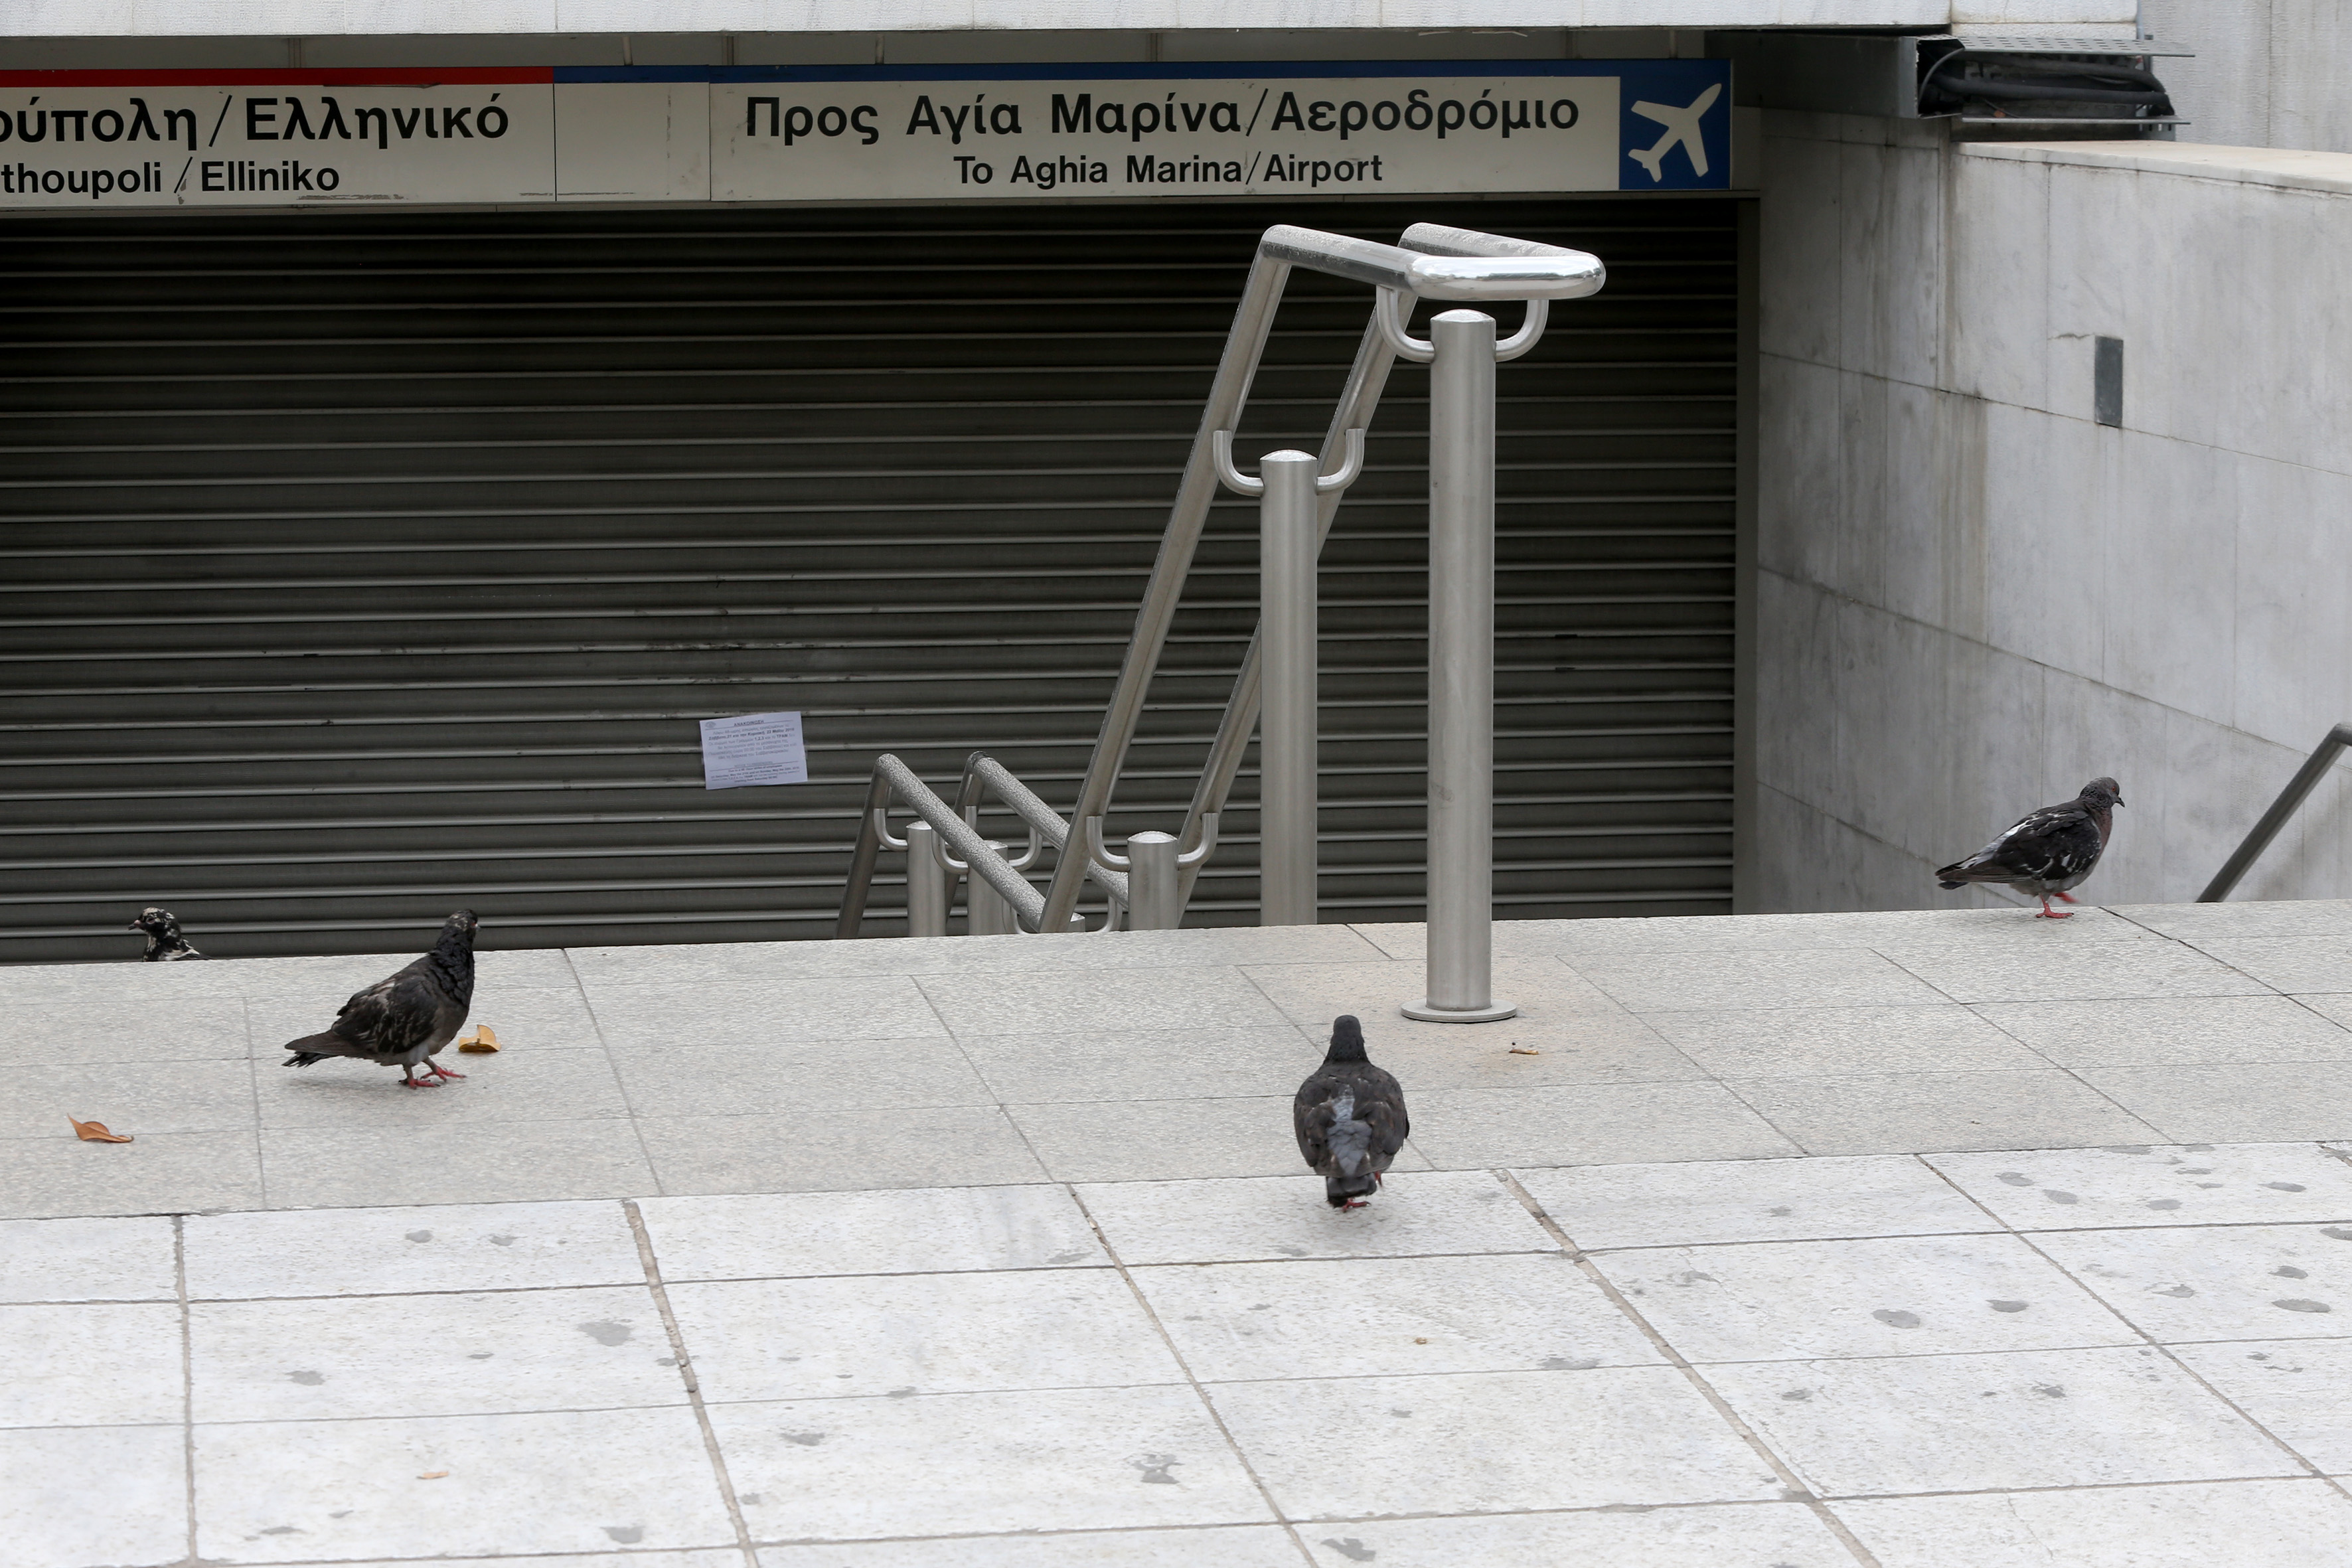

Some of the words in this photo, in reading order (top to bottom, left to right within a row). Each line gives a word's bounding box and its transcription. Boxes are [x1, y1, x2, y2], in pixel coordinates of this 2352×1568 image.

[246, 92, 509, 150] Ελληνικό
[746, 96, 879, 146] Προς
[905, 93, 1022, 145] Αγία
[1, 160, 161, 200] thoupoli
[201, 159, 339, 192] Elliniko
[953, 155, 993, 184] To
[1010, 155, 1108, 190] Aghia
